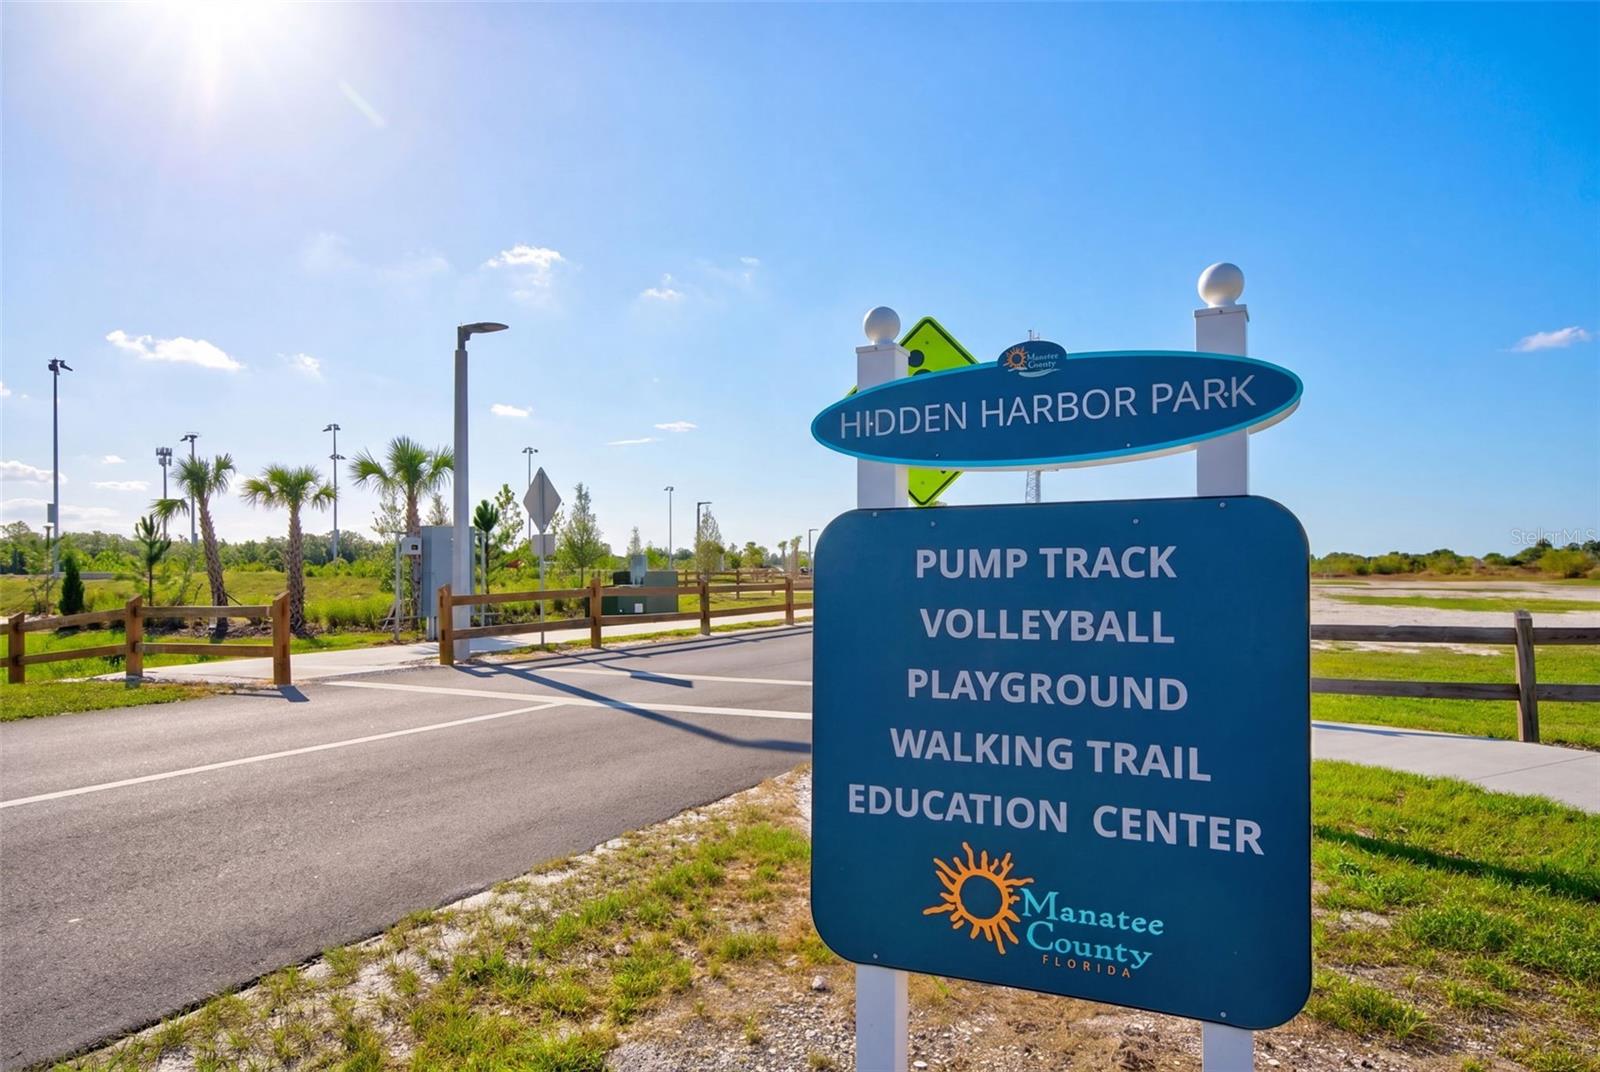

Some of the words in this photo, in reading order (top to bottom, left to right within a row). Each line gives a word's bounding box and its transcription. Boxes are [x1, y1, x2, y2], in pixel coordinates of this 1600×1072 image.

[1027, 360, 1057, 369] County
[840, 401, 967, 439] HIDDEN
[981, 387, 1137, 428] HARBOR
[1151, 374, 1256, 414] PARK
[916, 548, 1028, 579] PUMP
[1039, 545, 1178, 579] TRACK
[919, 608, 1176, 644] VOLLEYBALL
[907, 668, 1189, 712] PLAYGROUND
[889, 727, 1074, 771] WALKING
[1086, 740, 1212, 782] TRAIL
[848, 783, 1068, 834] EDUCATION
[1093, 804, 1265, 856] CENTER
[1020, 887, 1165, 936] Manatee
[1026, 920, 1153, 970] County
[1041, 953, 1132, 979] FLORIDA
